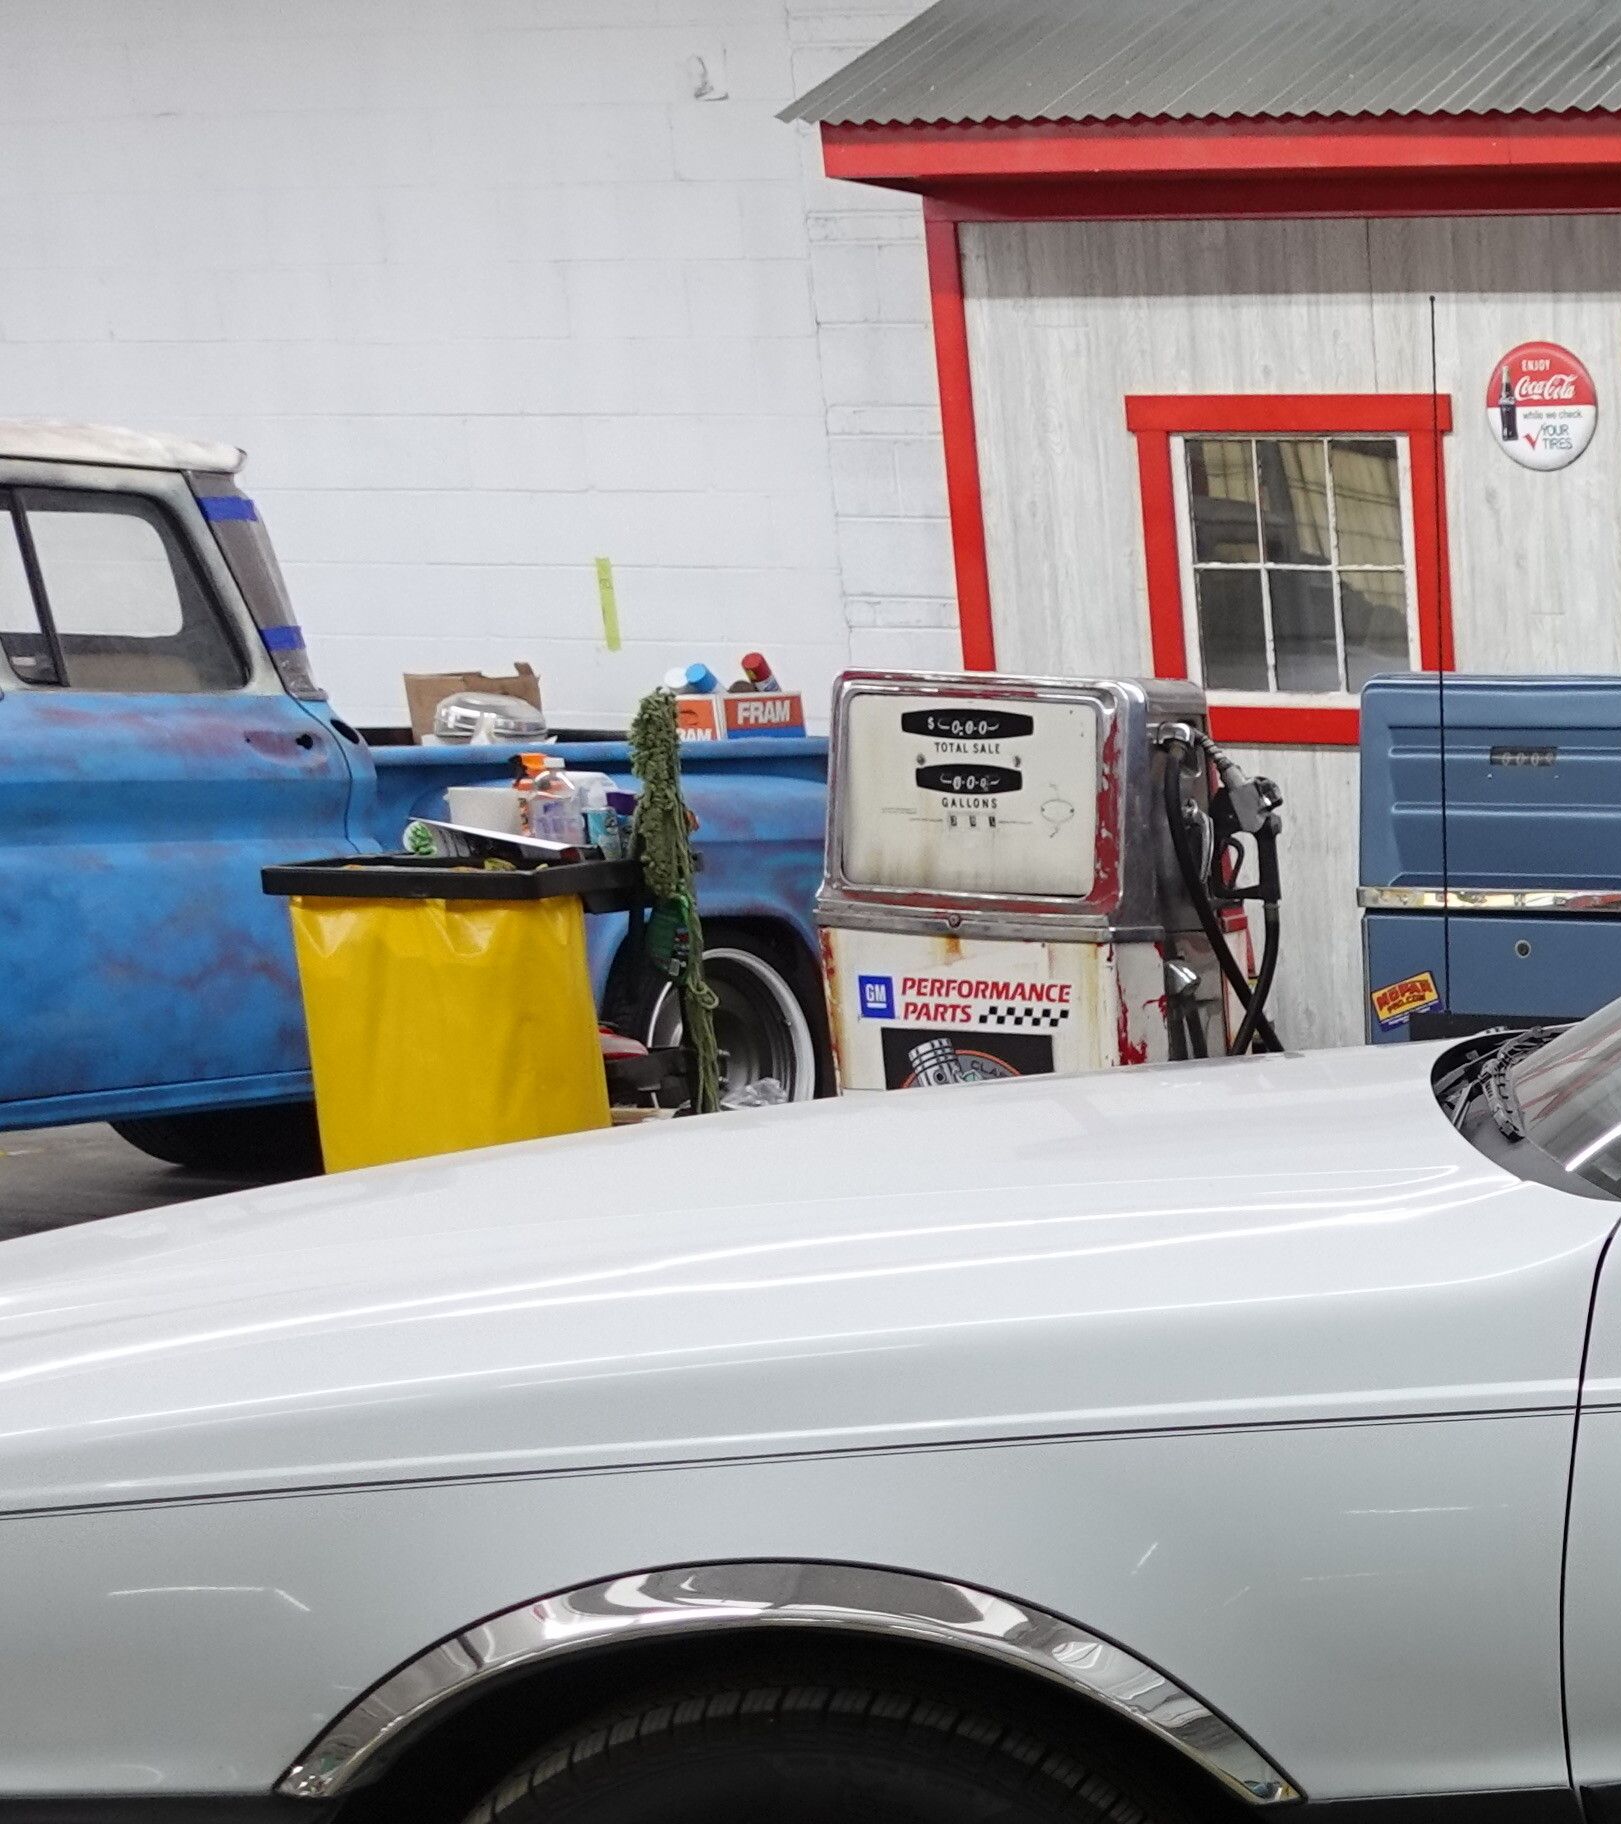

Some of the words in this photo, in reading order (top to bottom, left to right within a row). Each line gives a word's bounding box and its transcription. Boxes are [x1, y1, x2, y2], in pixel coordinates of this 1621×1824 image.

[1521, 359, 1551, 372] ENJOY
[1541, 423, 1569, 436] YOUR
[1542, 437, 1573, 450] TIRES
[737, 700, 791, 724] FRAM
[676, 728, 712, 740] RAM
[935, 742, 968, 753] TOTAL
[972, 743, 1001, 755] SALE
[942, 797, 998, 809] GALLONS
[866, 983, 887, 1001] GM
[901, 977, 1073, 1003] PERFORMANCE
[902, 1002, 972, 1023] PARTS
